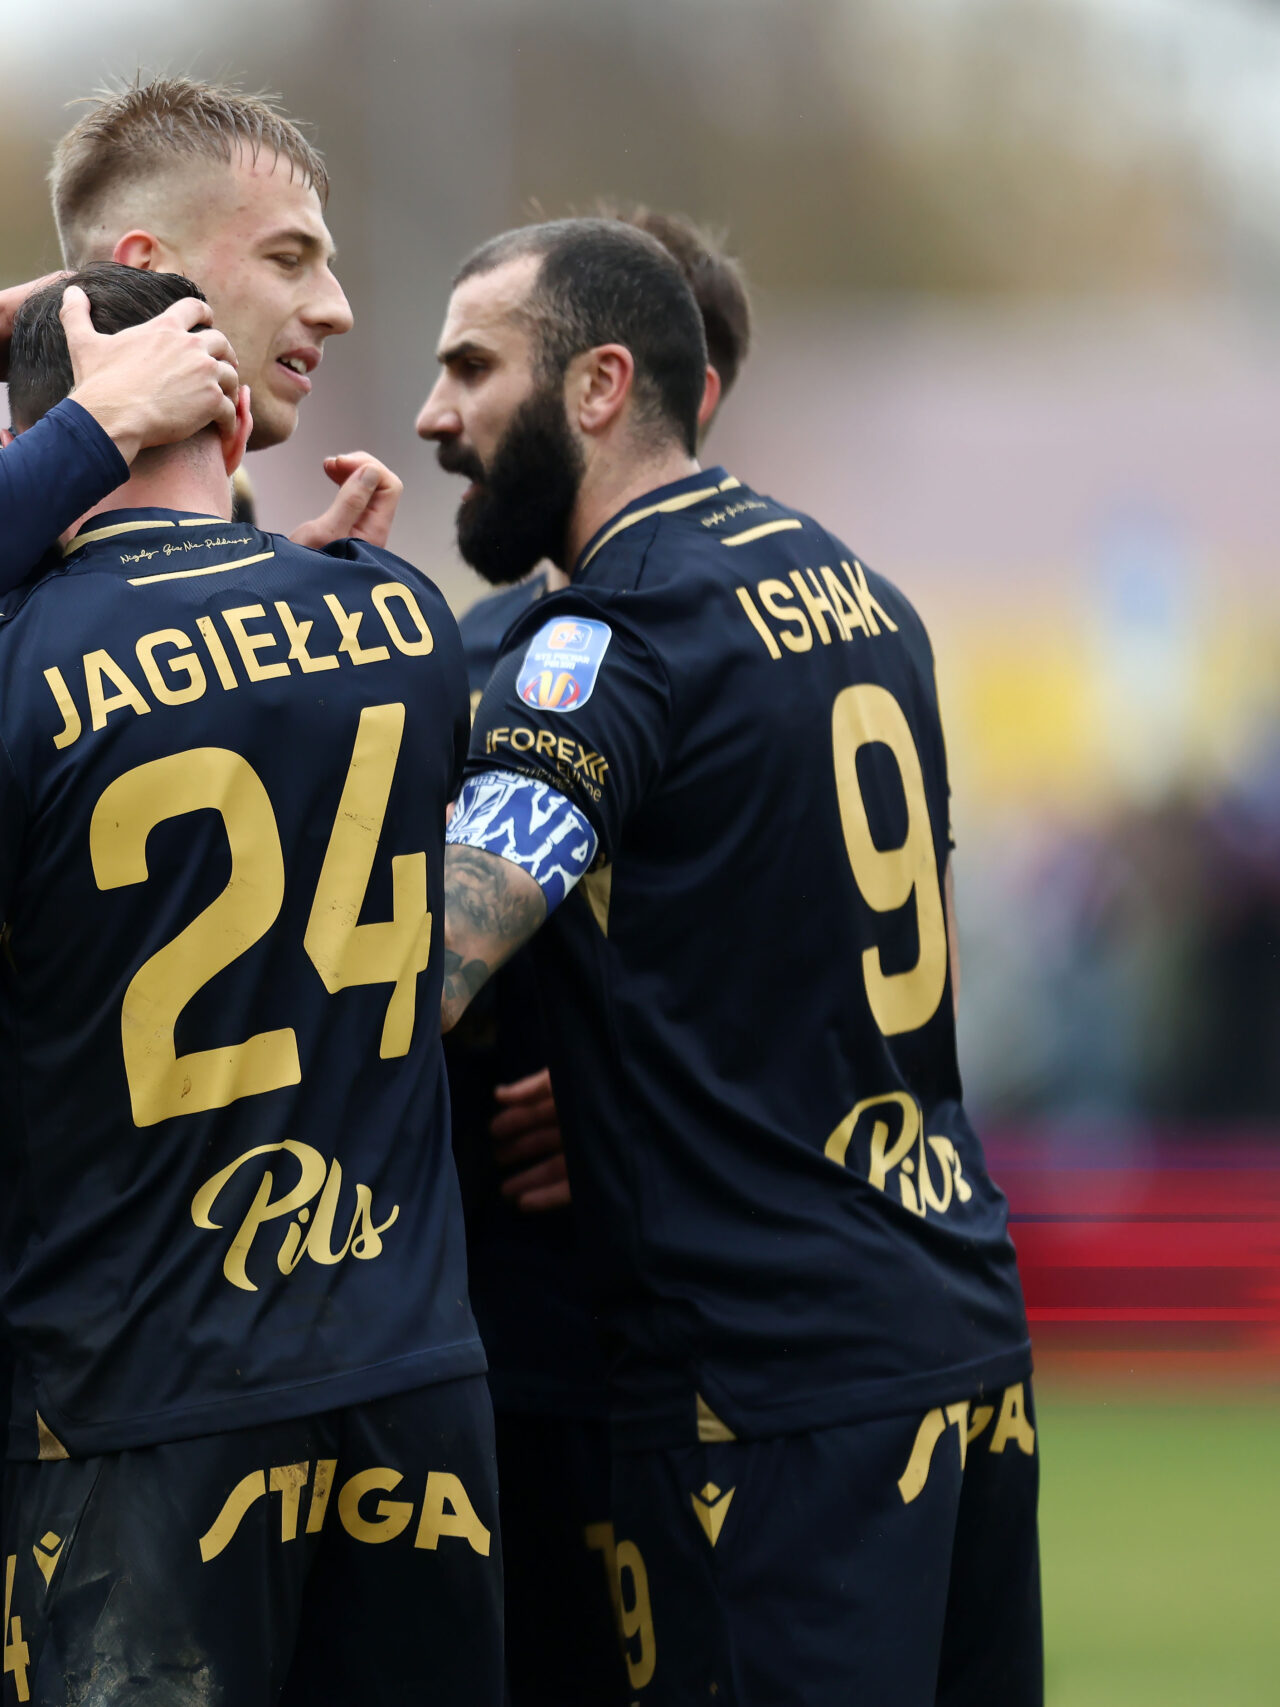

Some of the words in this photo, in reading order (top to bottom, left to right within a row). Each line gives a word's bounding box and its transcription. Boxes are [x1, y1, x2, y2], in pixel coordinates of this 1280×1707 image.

[43, 581, 435, 750] JAGIEŁŁO
[735, 559, 900, 661] ISHAK
[89, 702, 433, 1128] 24
[831, 683, 948, 1037] 9
[191, 1139, 400, 1291] Pils
[198, 1459, 491, 1563] STIGA
